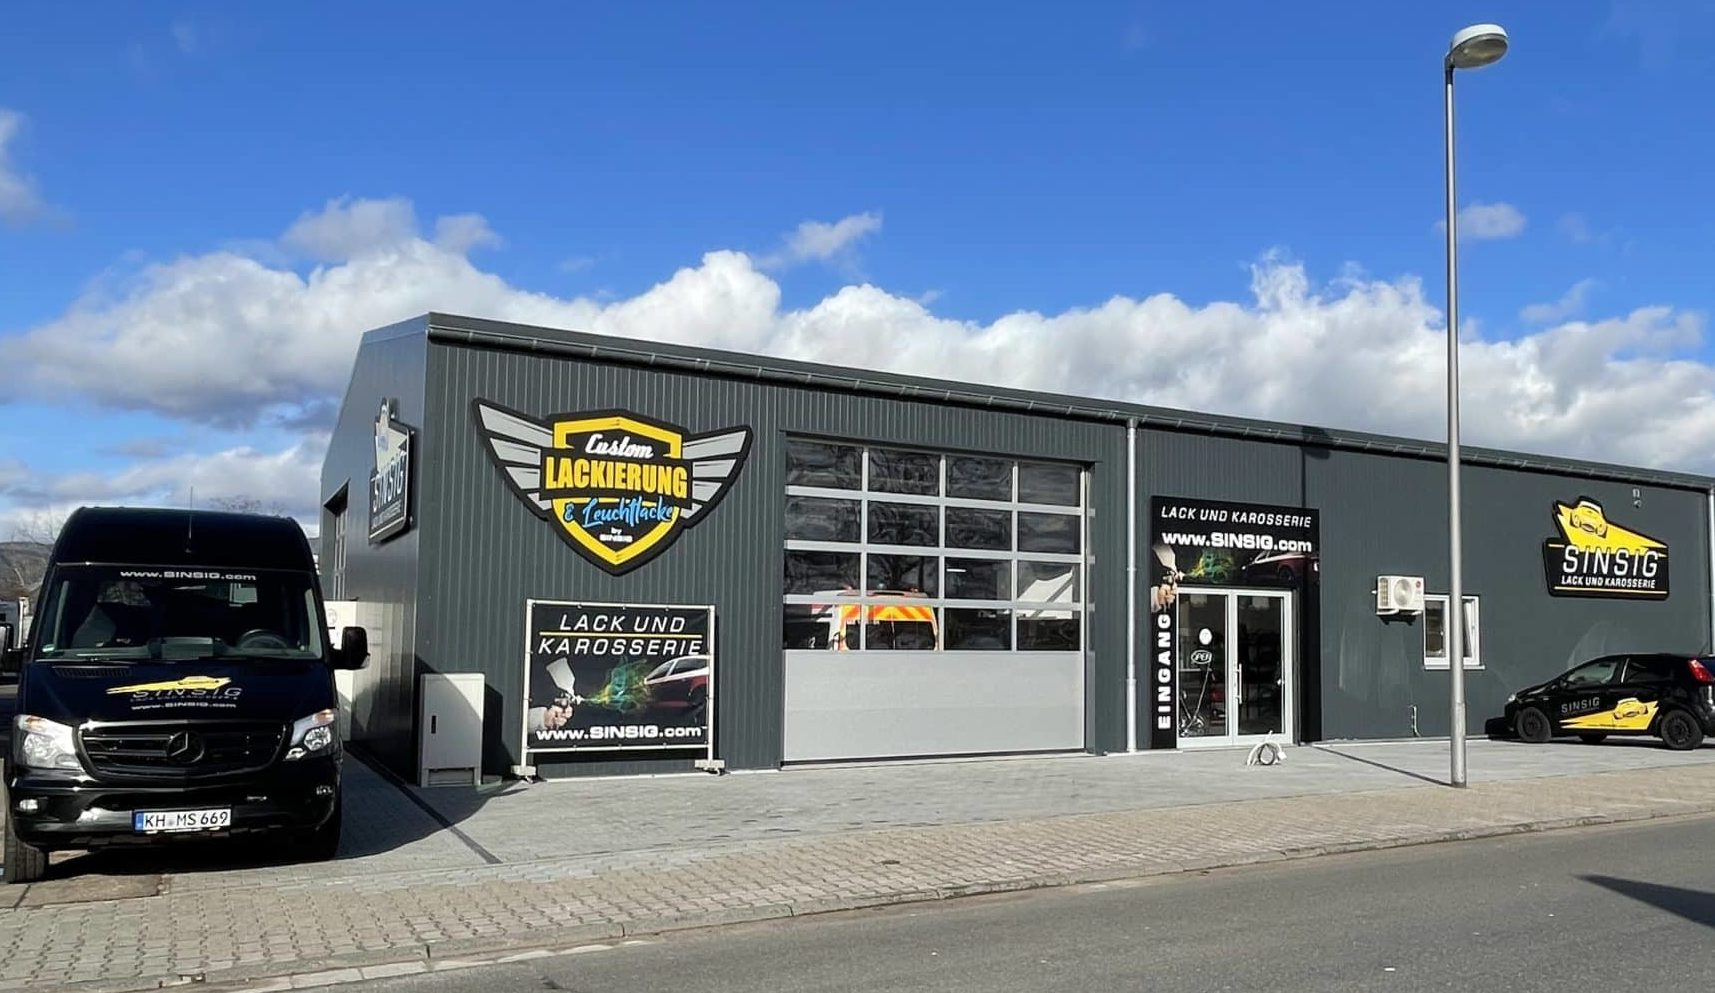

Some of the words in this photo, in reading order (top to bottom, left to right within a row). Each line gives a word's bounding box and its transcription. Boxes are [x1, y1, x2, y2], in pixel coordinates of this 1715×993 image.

[585, 433, 654, 458] Custom
[545, 456, 688, 499] LACKIERUNG
[582, 496, 673, 528] Leuchtlacke
[1161, 506, 1197, 520] LACK
[1200, 509, 1228, 522] UND
[1231, 511, 1312, 528] KAROSSERIE
[1162, 531, 1312, 553] www.SINSIG.com
[1563, 545, 1659, 578] SINSIG
[120, 570, 257, 581] www.SINSIG.com
[1561, 575, 1584, 586] LACK
[1585, 576, 1603, 587] UND
[1605, 577, 1656, 589] KAROSSERIE
[560, 614, 626, 632] LACK
[633, 616, 686, 633] UND
[538, 638, 703, 656] KAROSSERIE
[1157, 613, 1171, 730] EINGANG
[133, 686, 243, 699] SINSIG
[1561, 696, 1601, 714] SINSIG
[536, 725, 702, 741] www.SINSIG.com
[145, 814, 166, 828] KH
[176, 813, 197, 826] MS
[200, 811, 228, 826] 669
